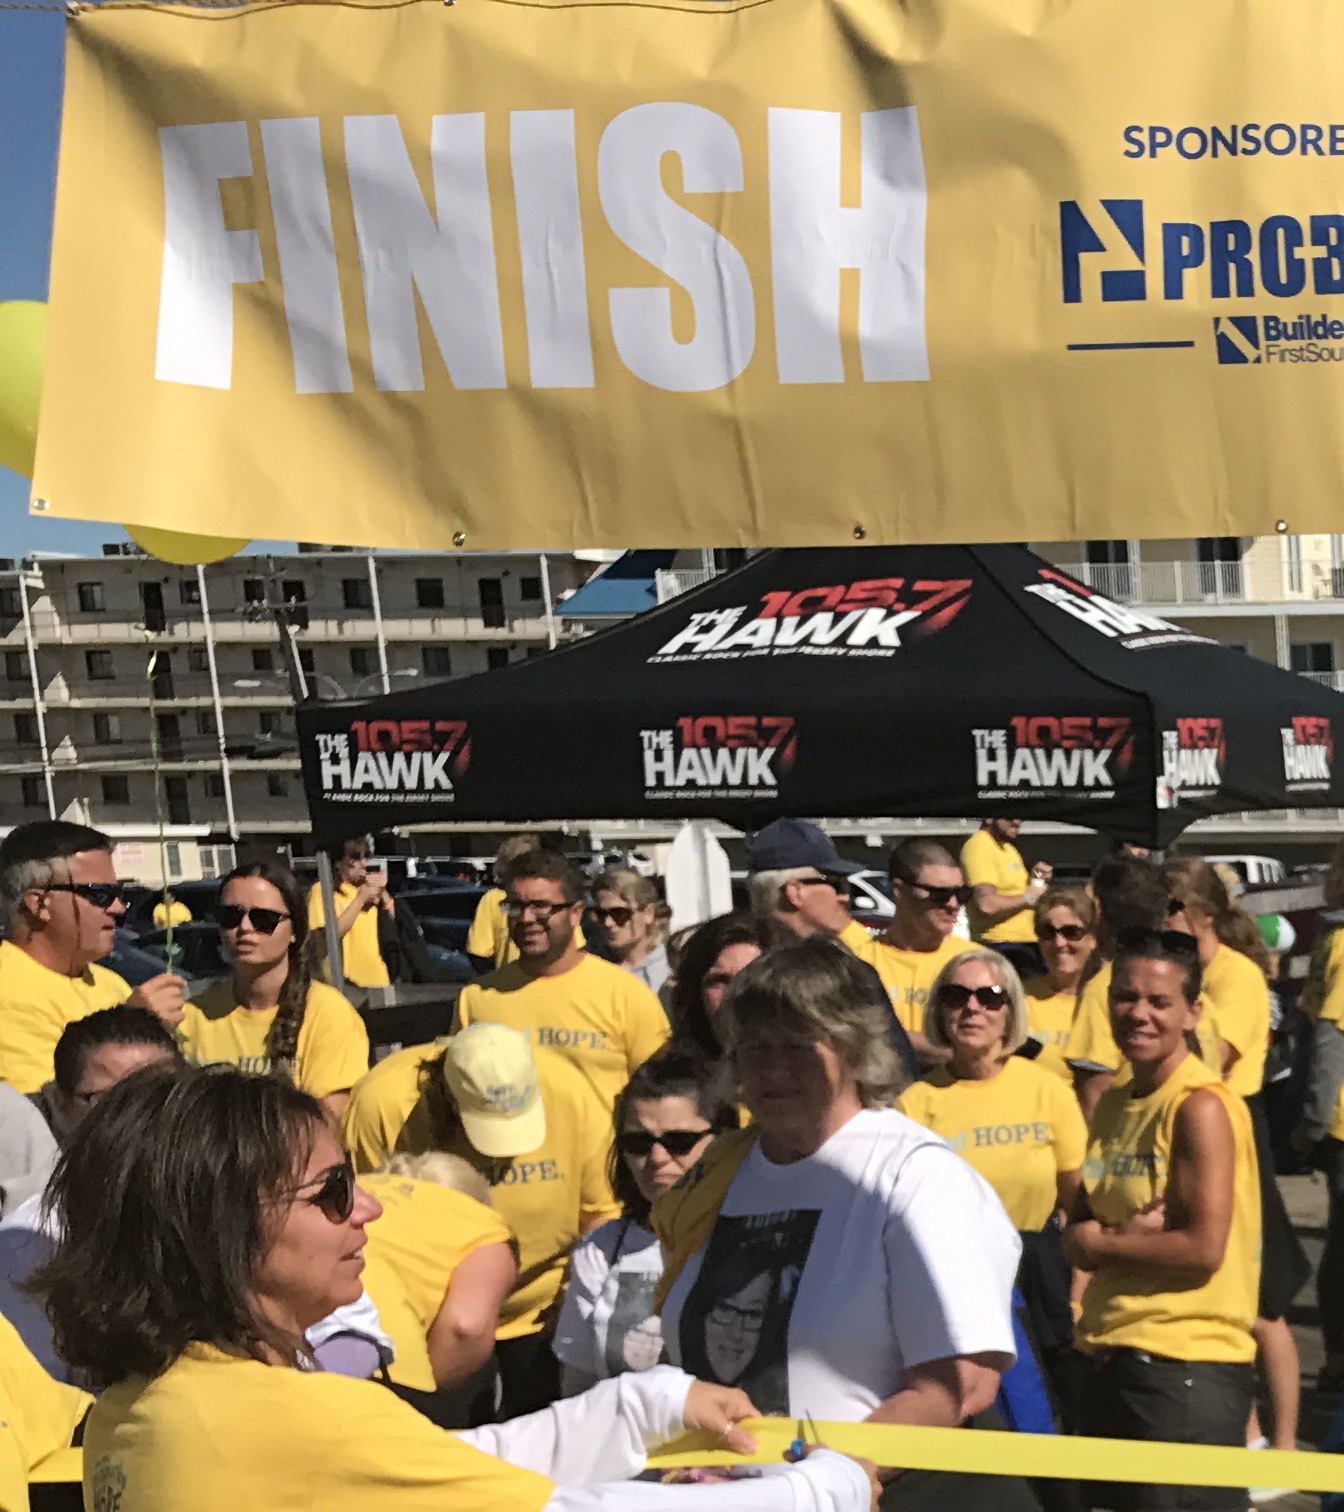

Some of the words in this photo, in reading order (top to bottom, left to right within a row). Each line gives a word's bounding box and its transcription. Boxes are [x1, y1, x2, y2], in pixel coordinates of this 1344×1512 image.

[155, 101, 930, 393] FINISH
[757, 578, 973, 619] 105.7
[656, 607, 922, 654] HAWK
[689, 605, 748, 627] THE
[315, 733, 349, 754] THE
[351, 720, 467, 752] 105.7
[639, 729, 673, 749] THE
[677, 715, 795, 748] 105.7
[970, 729, 1007, 749] THE
[1010, 715, 1131, 748] 105.7
[320, 751, 454, 790] HAWK
[643, 746, 778, 787] HAWK
[976, 747, 1115, 787] HAWK
